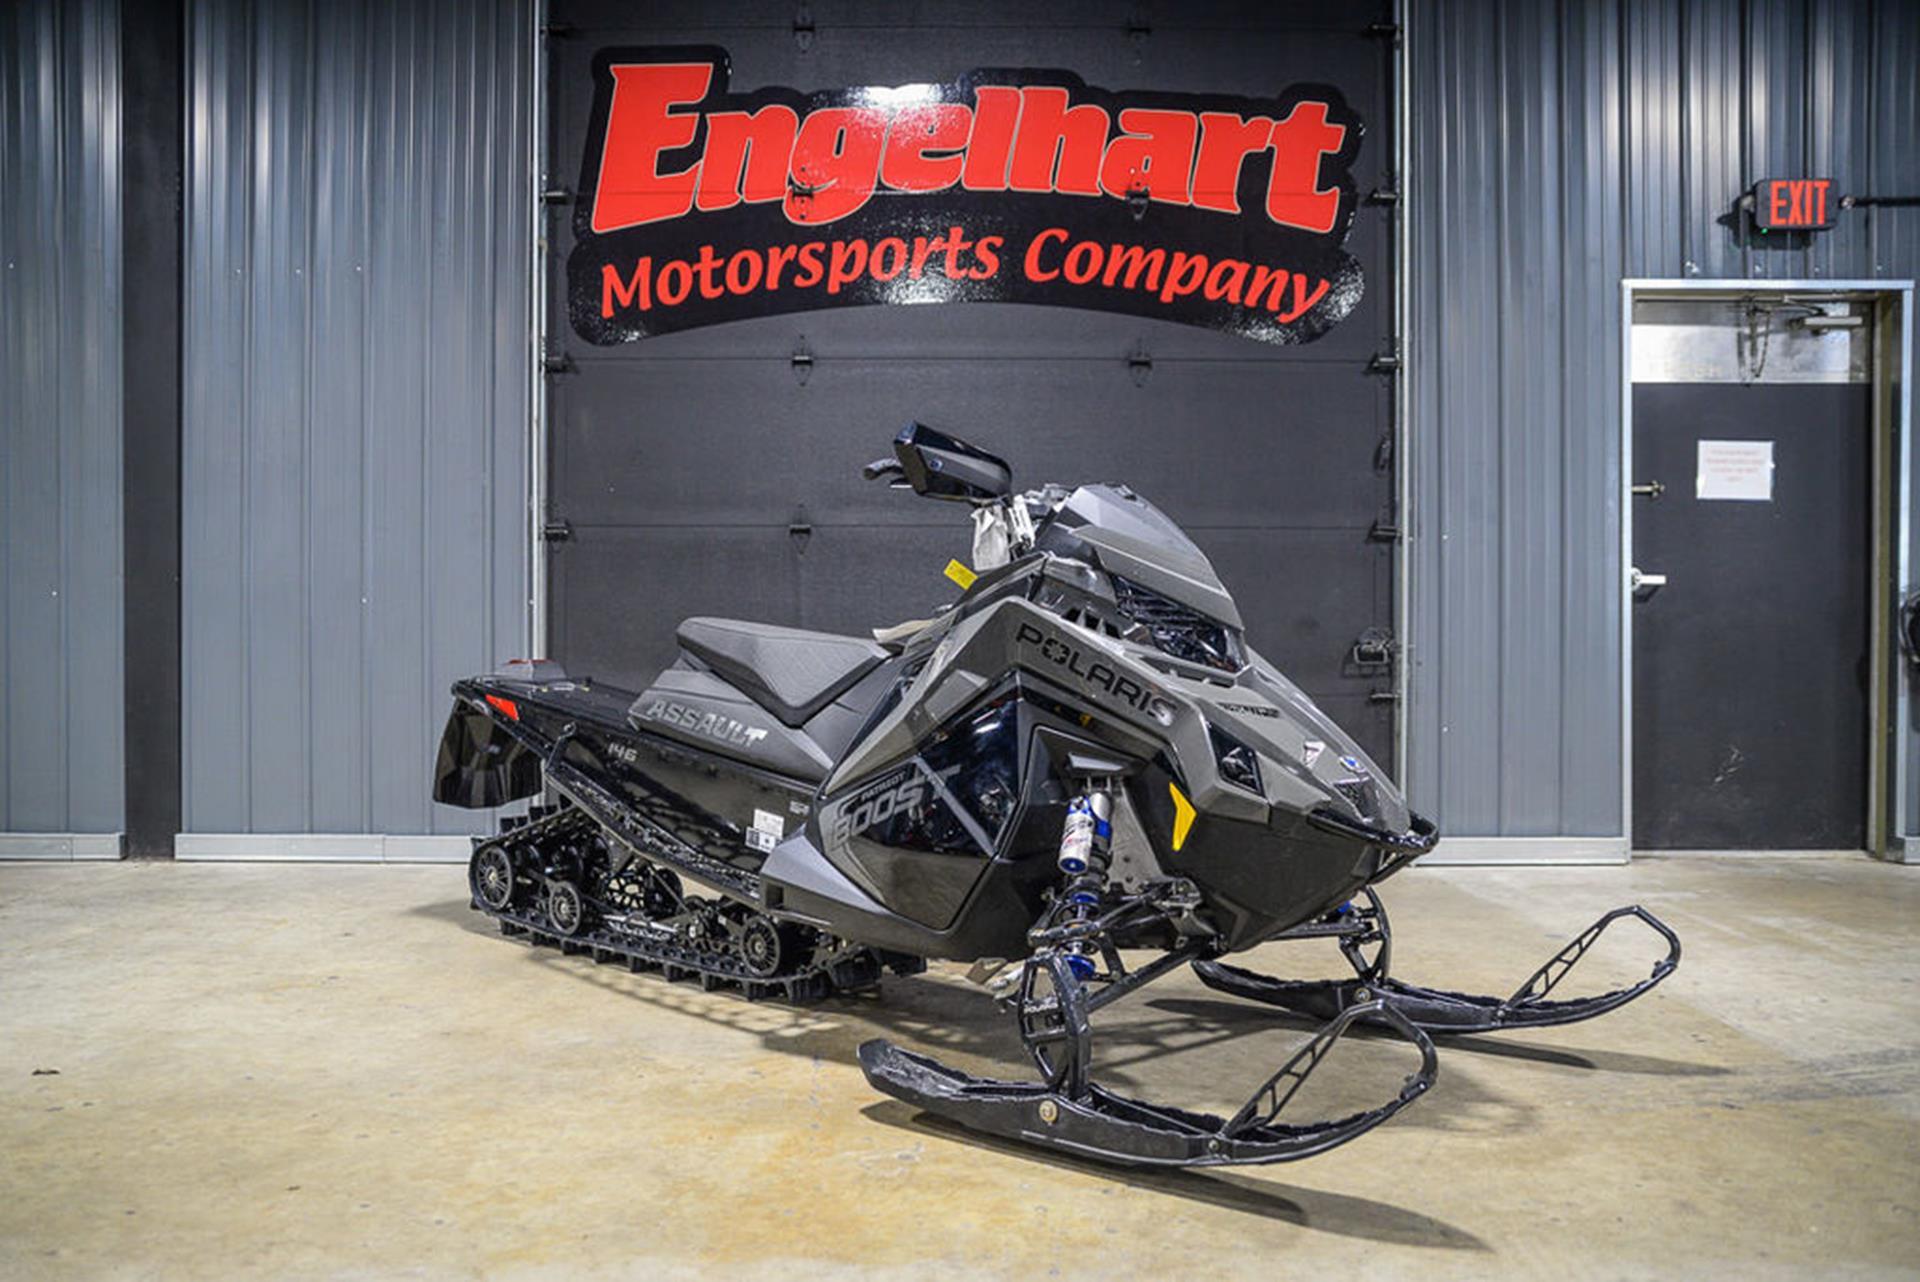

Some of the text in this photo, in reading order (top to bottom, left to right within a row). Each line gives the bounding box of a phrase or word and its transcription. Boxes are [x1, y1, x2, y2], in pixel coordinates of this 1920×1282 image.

[592, 63, 1346, 233] Engelhart
[1770, 180, 1830, 225] EXIT
[601, 226, 1331, 325] Motorsports Company
[1016, 623, 1177, 726] POLARIS
[608, 743, 638, 762] 146
[647, 699, 769, 748] ASSAULT
